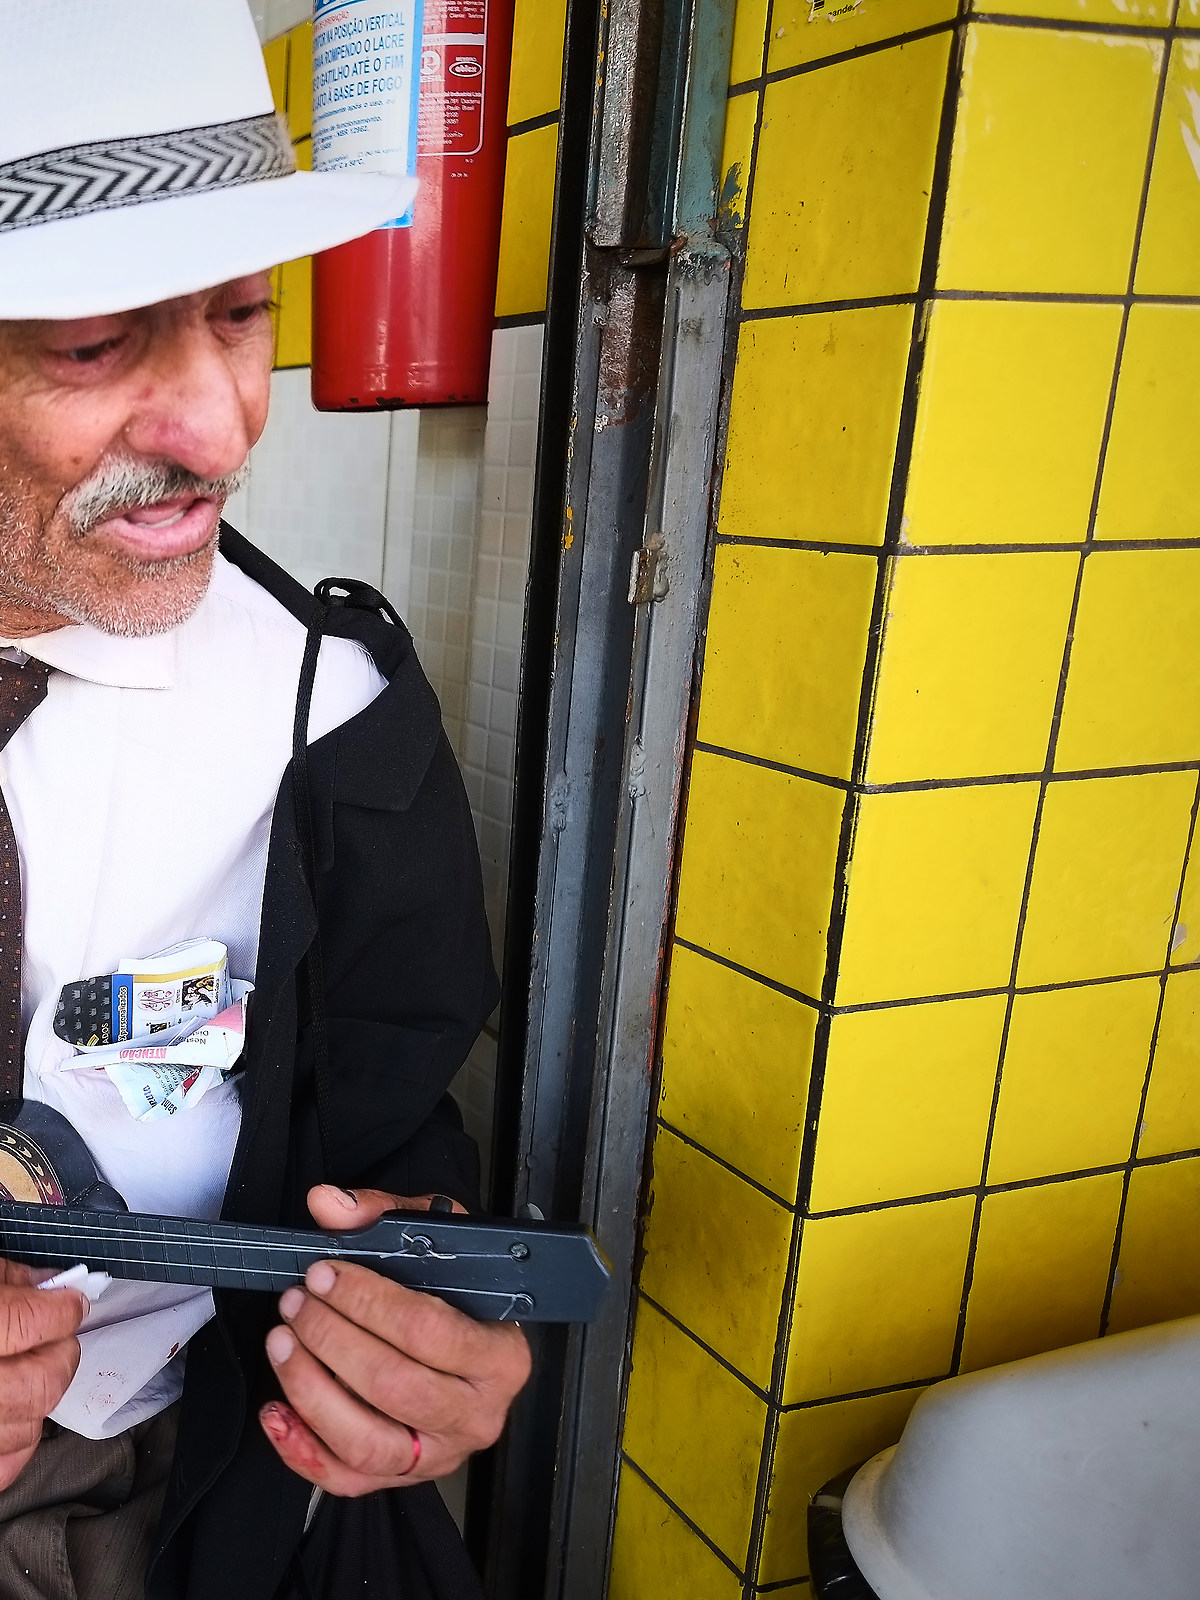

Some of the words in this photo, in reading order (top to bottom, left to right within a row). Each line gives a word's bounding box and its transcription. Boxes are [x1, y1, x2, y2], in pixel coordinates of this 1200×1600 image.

[333, 18, 363, 40] POSIÇÃO
[366, 12, 405, 31] VERTICAL
[325, 41, 362, 63] ROMPENDO
[364, 39, 371, 53] O
[373, 33, 404, 51] LACRE
[320, 65, 350, 87] GATILHO
[351, 57, 370, 76] ATÉ
[373, 58, 381, 72] O
[385, 55, 404, 70] FIM
[334, 84, 354, 102] BASE
[357, 80, 369, 96] DE
[373, 76, 403, 93] FOGO
